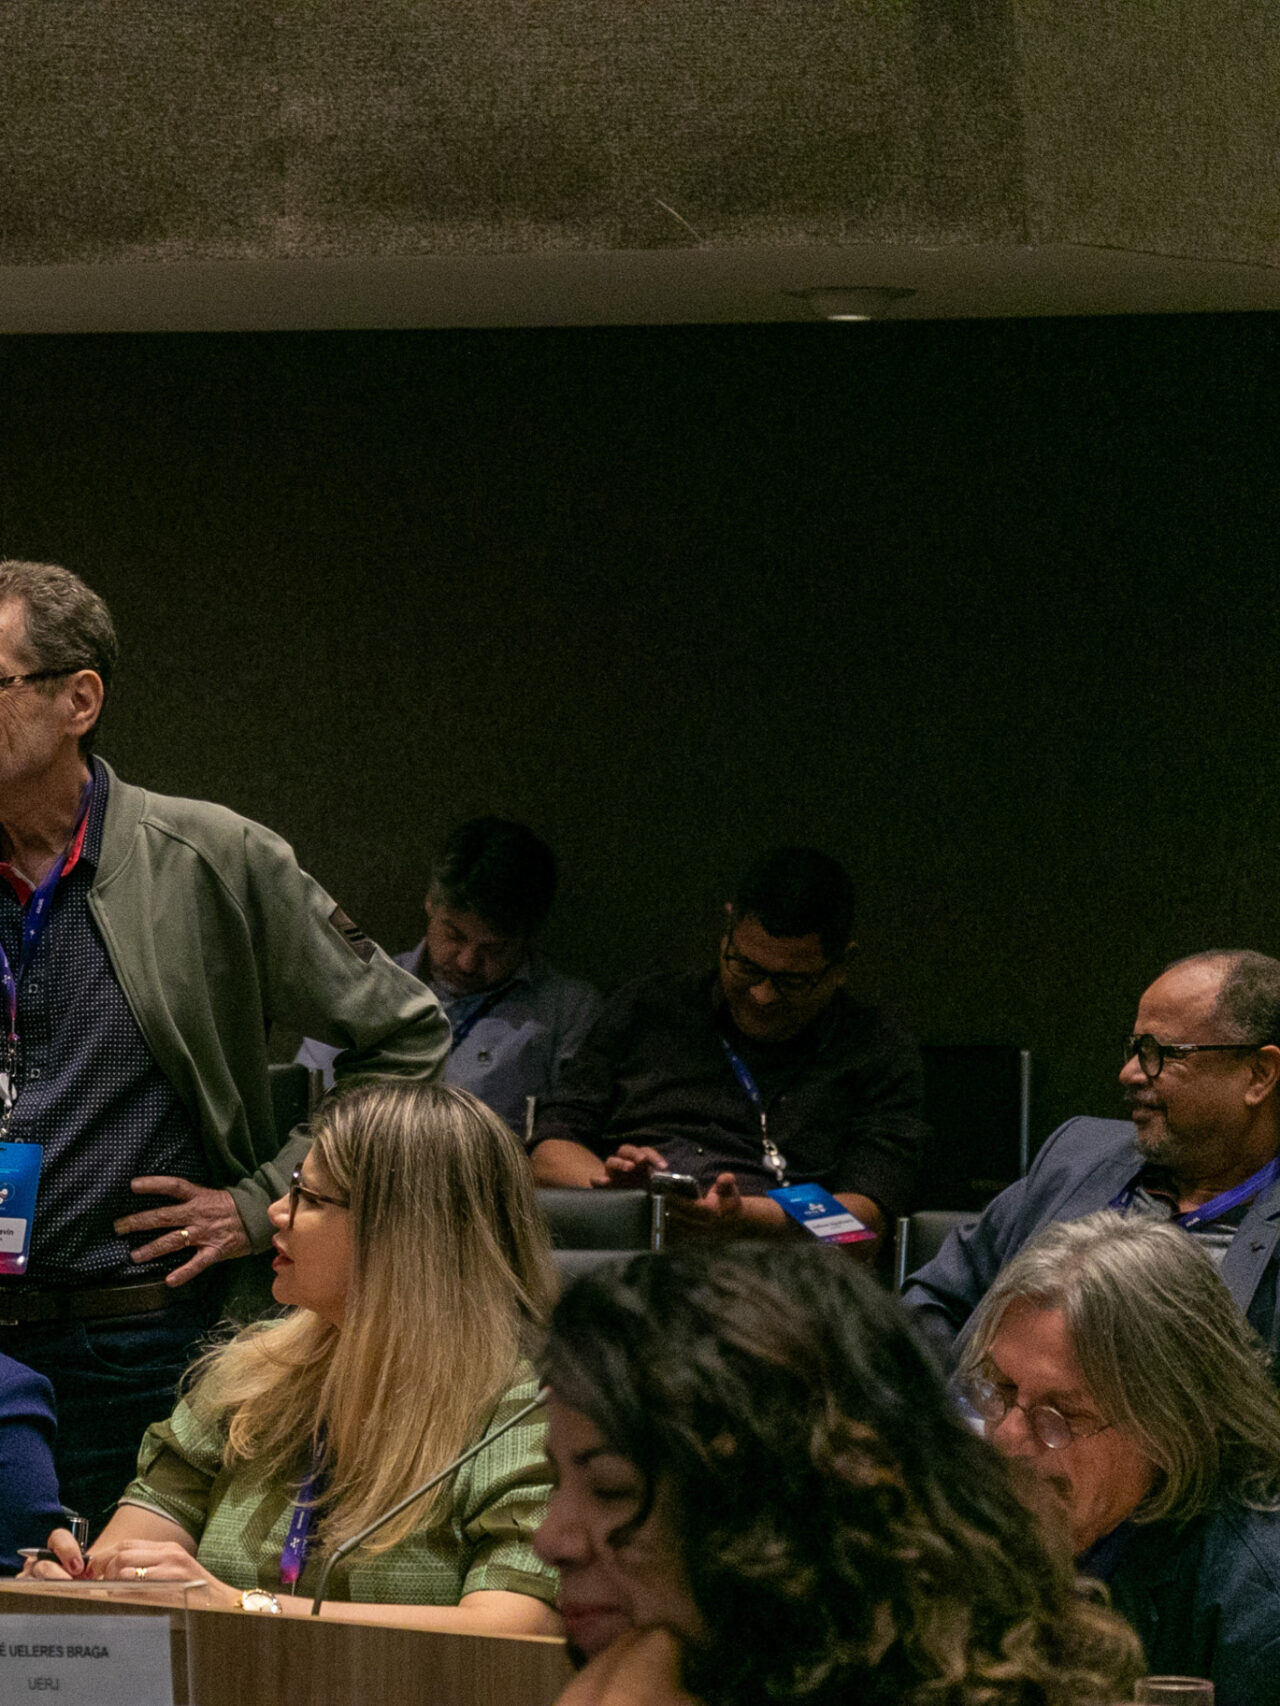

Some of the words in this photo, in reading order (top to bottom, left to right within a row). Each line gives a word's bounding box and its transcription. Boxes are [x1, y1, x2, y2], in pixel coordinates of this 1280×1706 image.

[9, 1644, 64, 1658] UELERES
[67, 1645, 109, 1659] BRAGA
[28, 1678, 59, 1691] UERJ
